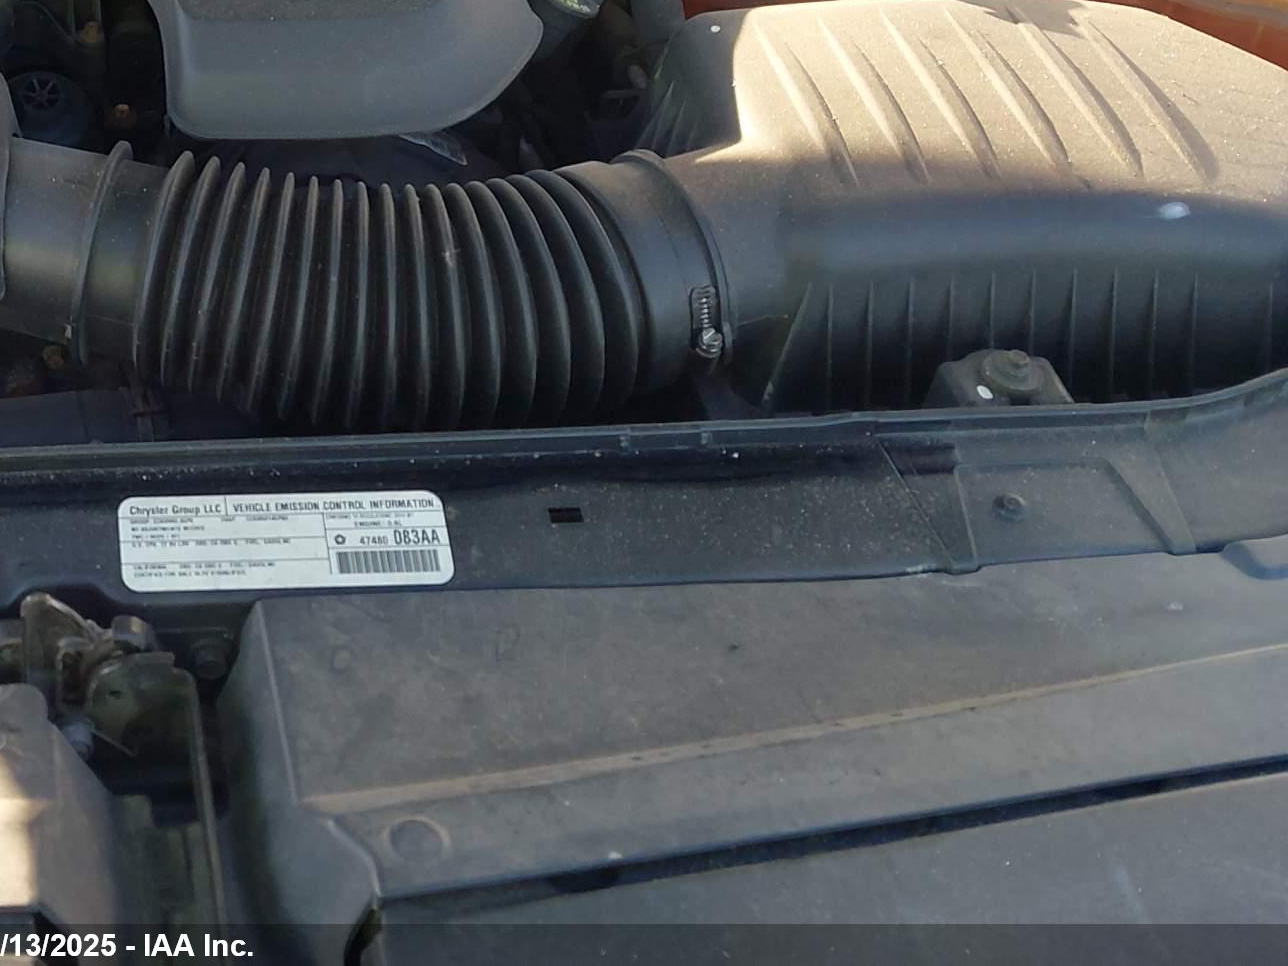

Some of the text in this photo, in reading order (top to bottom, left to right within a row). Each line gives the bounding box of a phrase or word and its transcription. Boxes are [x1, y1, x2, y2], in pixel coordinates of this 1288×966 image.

[129, 504, 222, 516] Chrysler Group LLC
[232, 497, 434, 513] VEHICLE EMISSION CONTROL INFORMATION
